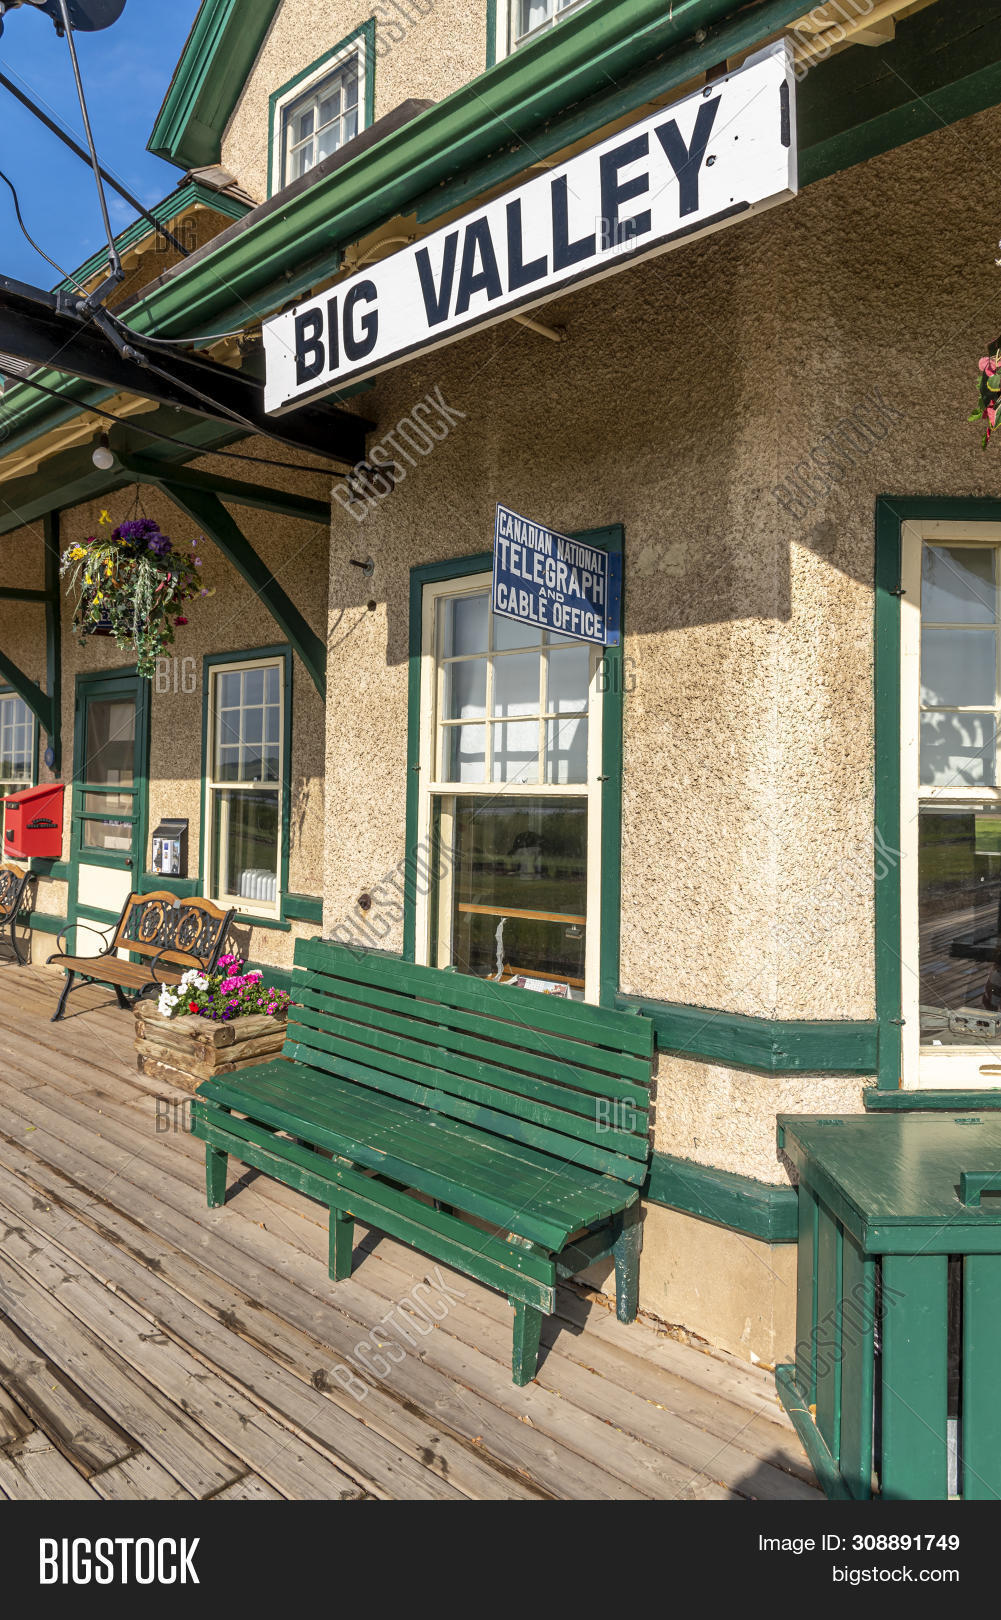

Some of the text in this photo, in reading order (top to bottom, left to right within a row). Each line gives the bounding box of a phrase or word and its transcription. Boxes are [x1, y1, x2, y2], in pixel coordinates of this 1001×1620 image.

[294, 95, 721, 386] BIG VALLEY
[499, 537, 604, 605] TELEGRAPH
[500, 512, 604, 575] CANADIAN NATIONAL
[498, 583, 603, 638] CABLE OFFICE
[539, 588, 564, 602] AND
